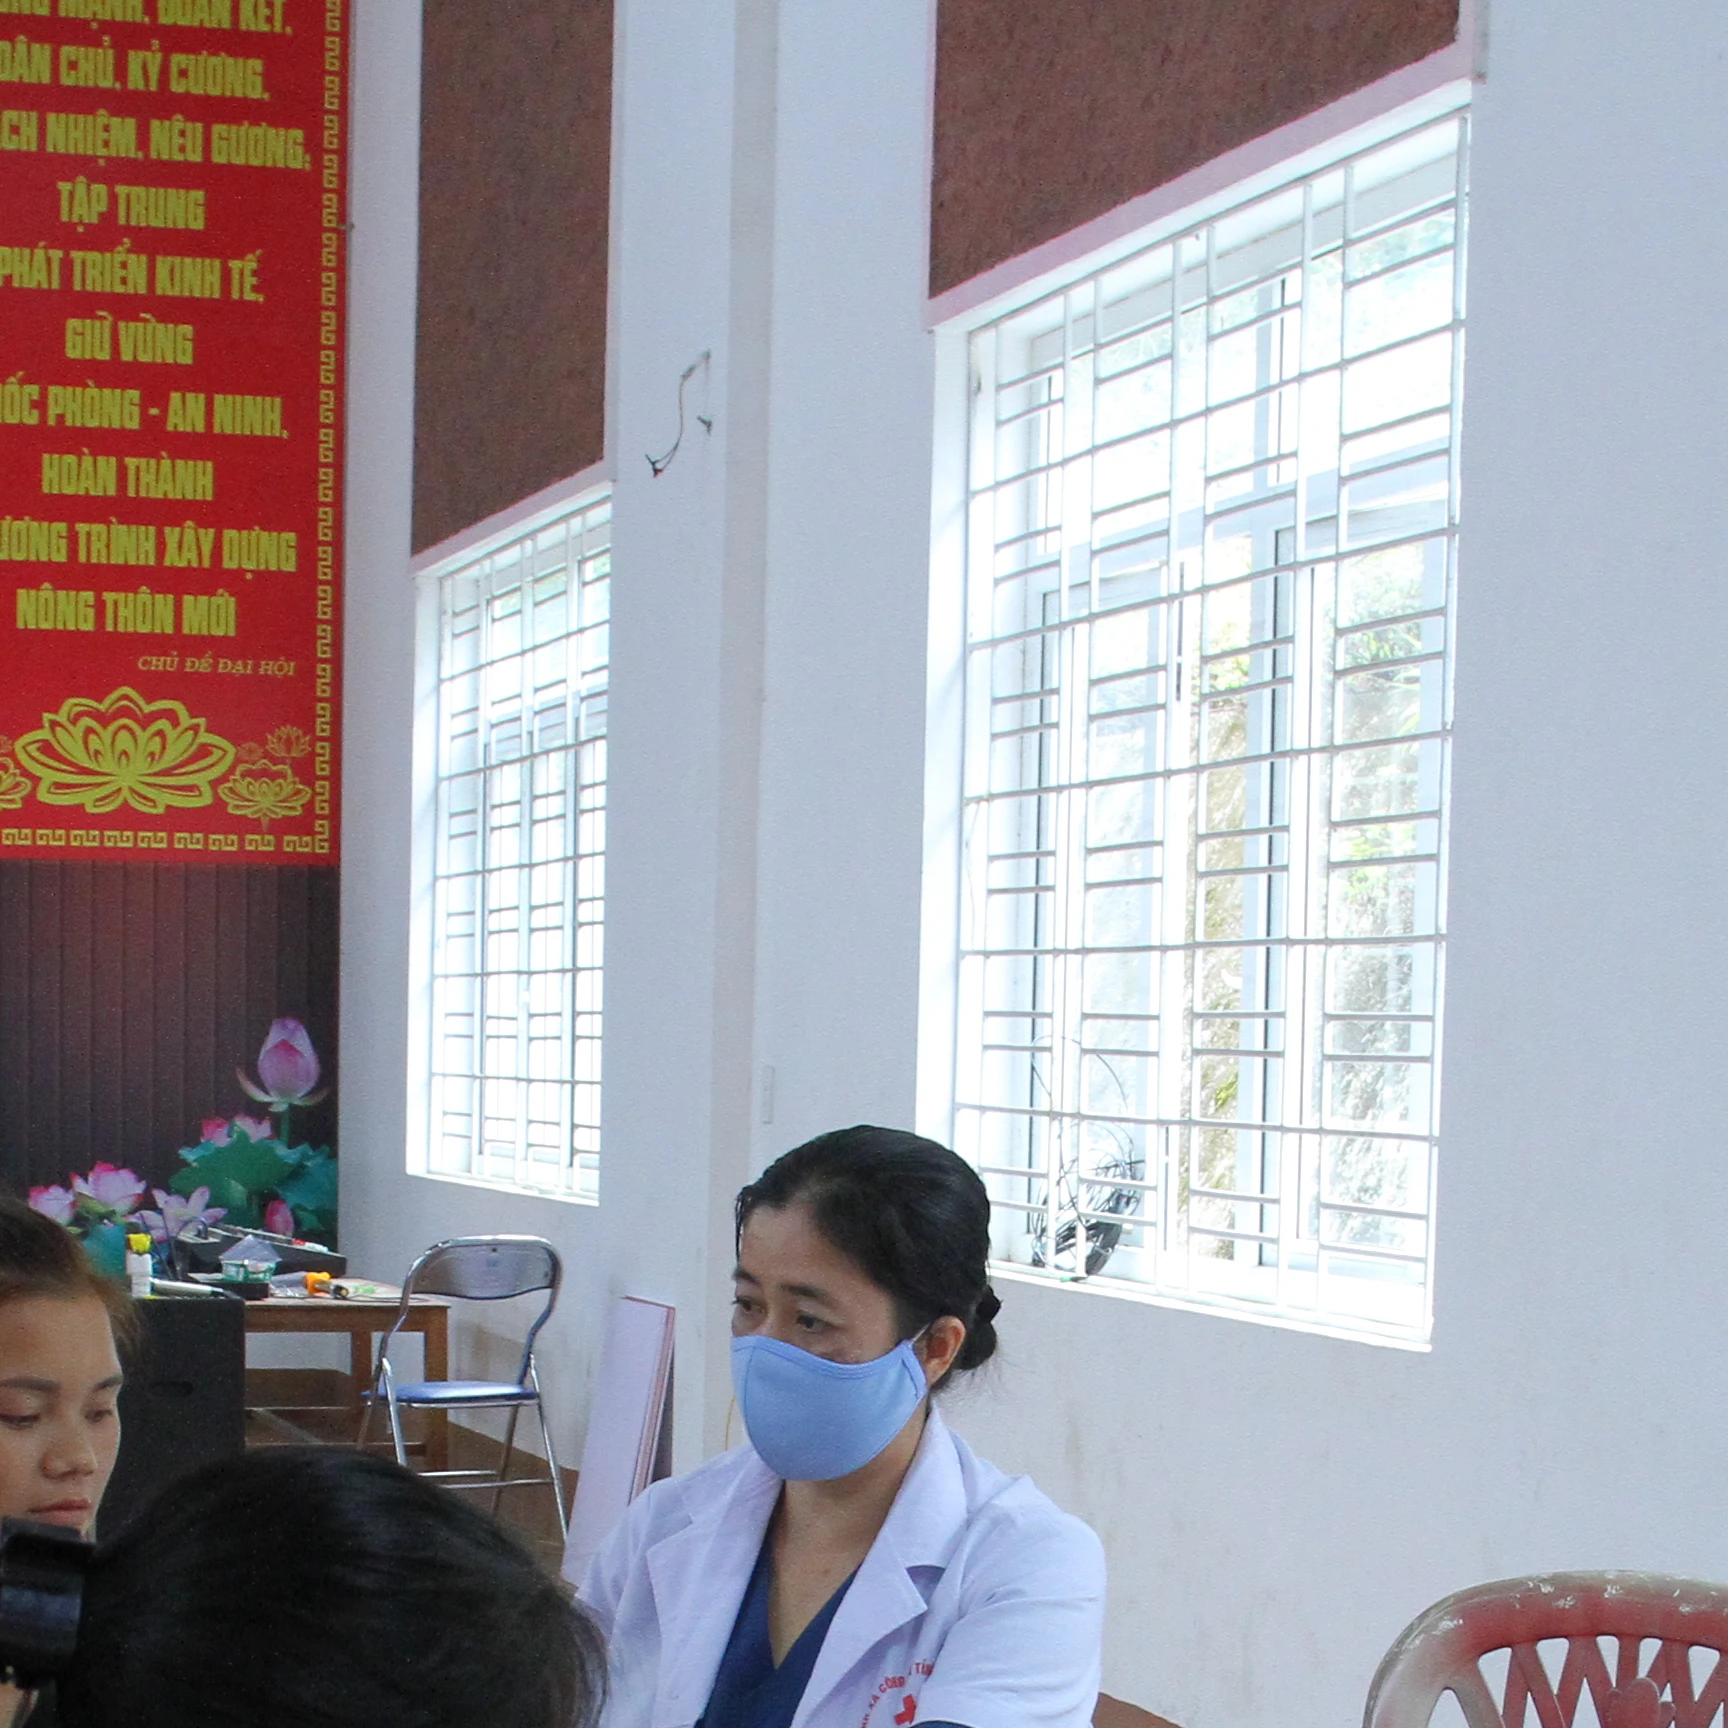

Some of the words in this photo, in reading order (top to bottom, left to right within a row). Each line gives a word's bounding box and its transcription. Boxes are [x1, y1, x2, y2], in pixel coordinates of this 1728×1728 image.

[128, 40, 162, 91] KỶ
[150, 114, 203, 162] NÊU
[57, 176, 108, 232] TẬP
[114, 185, 205, 230] TRUNG
[70, 238, 148, 294] TRIỂN
[155, 256, 221, 298] KINH
[65, 311, 114, 360] GIỮ
[118, 313, 193, 364] VỮNG
[47, 380, 140, 430] PHÒNG
[166, 392, 206, 433] AN
[42, 448, 117, 496] HOÀN
[124, 452, 213, 501] THÀNH
[75, 517, 157, 566] TRÌNH
[163, 520, 215, 568] XÂY
[222, 526, 297, 579] DỰNG
[16, 582, 95, 631] NÔNG
[102, 586, 175, 634] THÔN
[182, 589, 236, 636] MỚI
[138, 651, 179, 671] CHỦ
[217, 658, 253, 676] ĐẠI
[259, 657, 296, 679] HỘI
